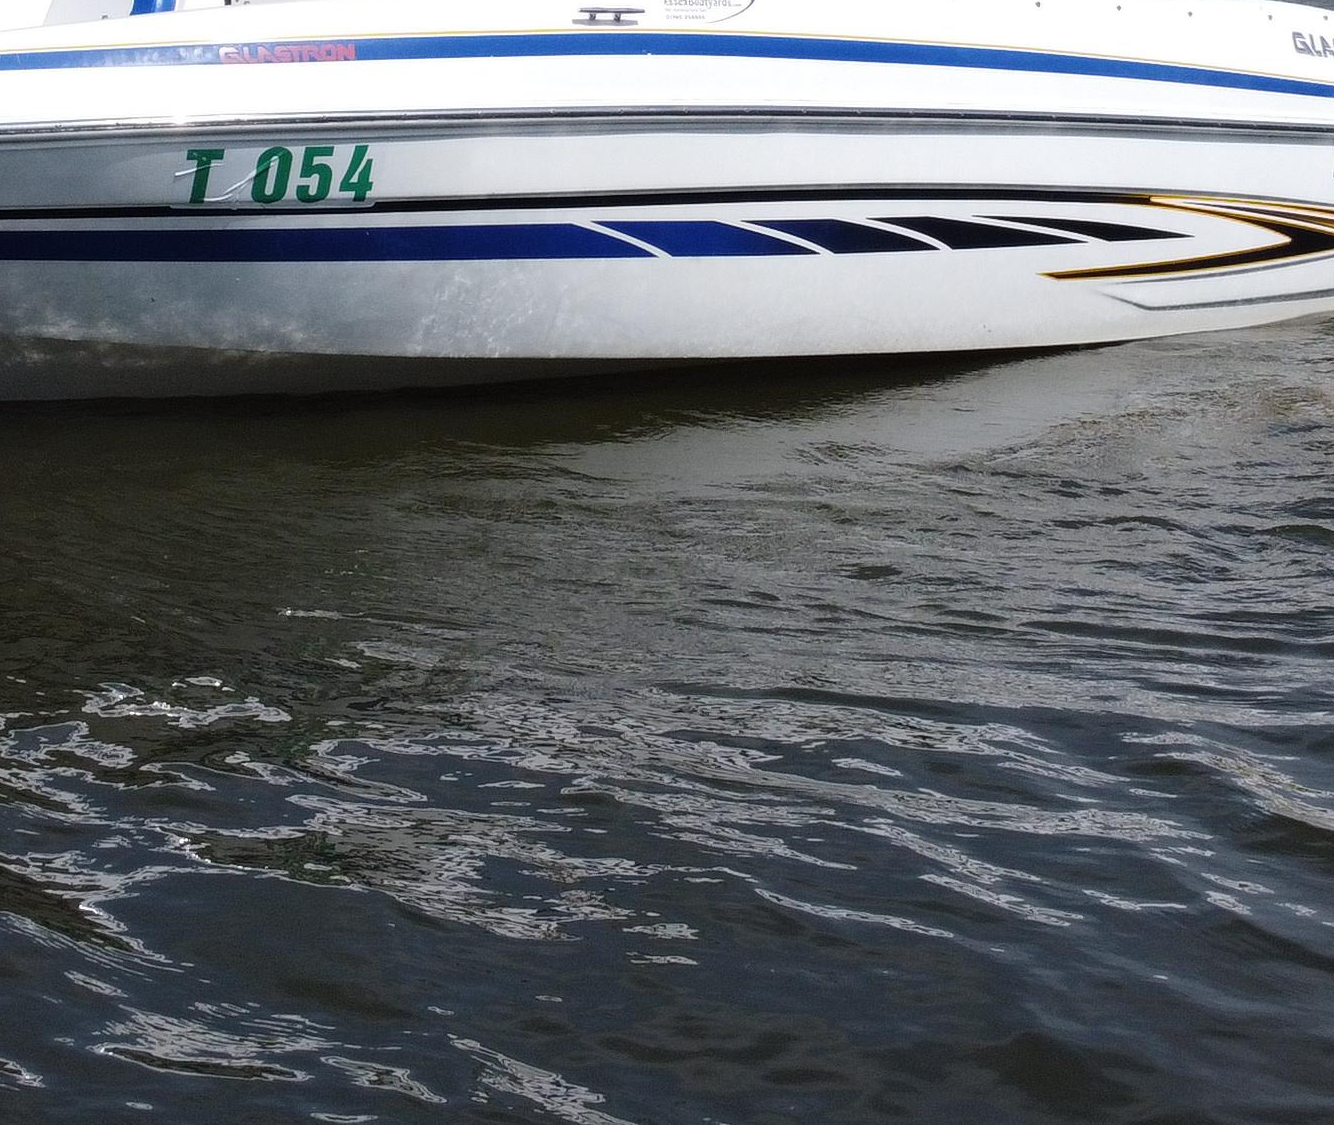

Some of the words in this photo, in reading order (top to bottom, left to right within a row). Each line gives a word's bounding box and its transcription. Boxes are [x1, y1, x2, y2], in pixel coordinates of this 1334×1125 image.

[219, 42, 356, 64] GLASTRON
[186, 148, 225, 204] T
[251, 144, 374, 204] 054
